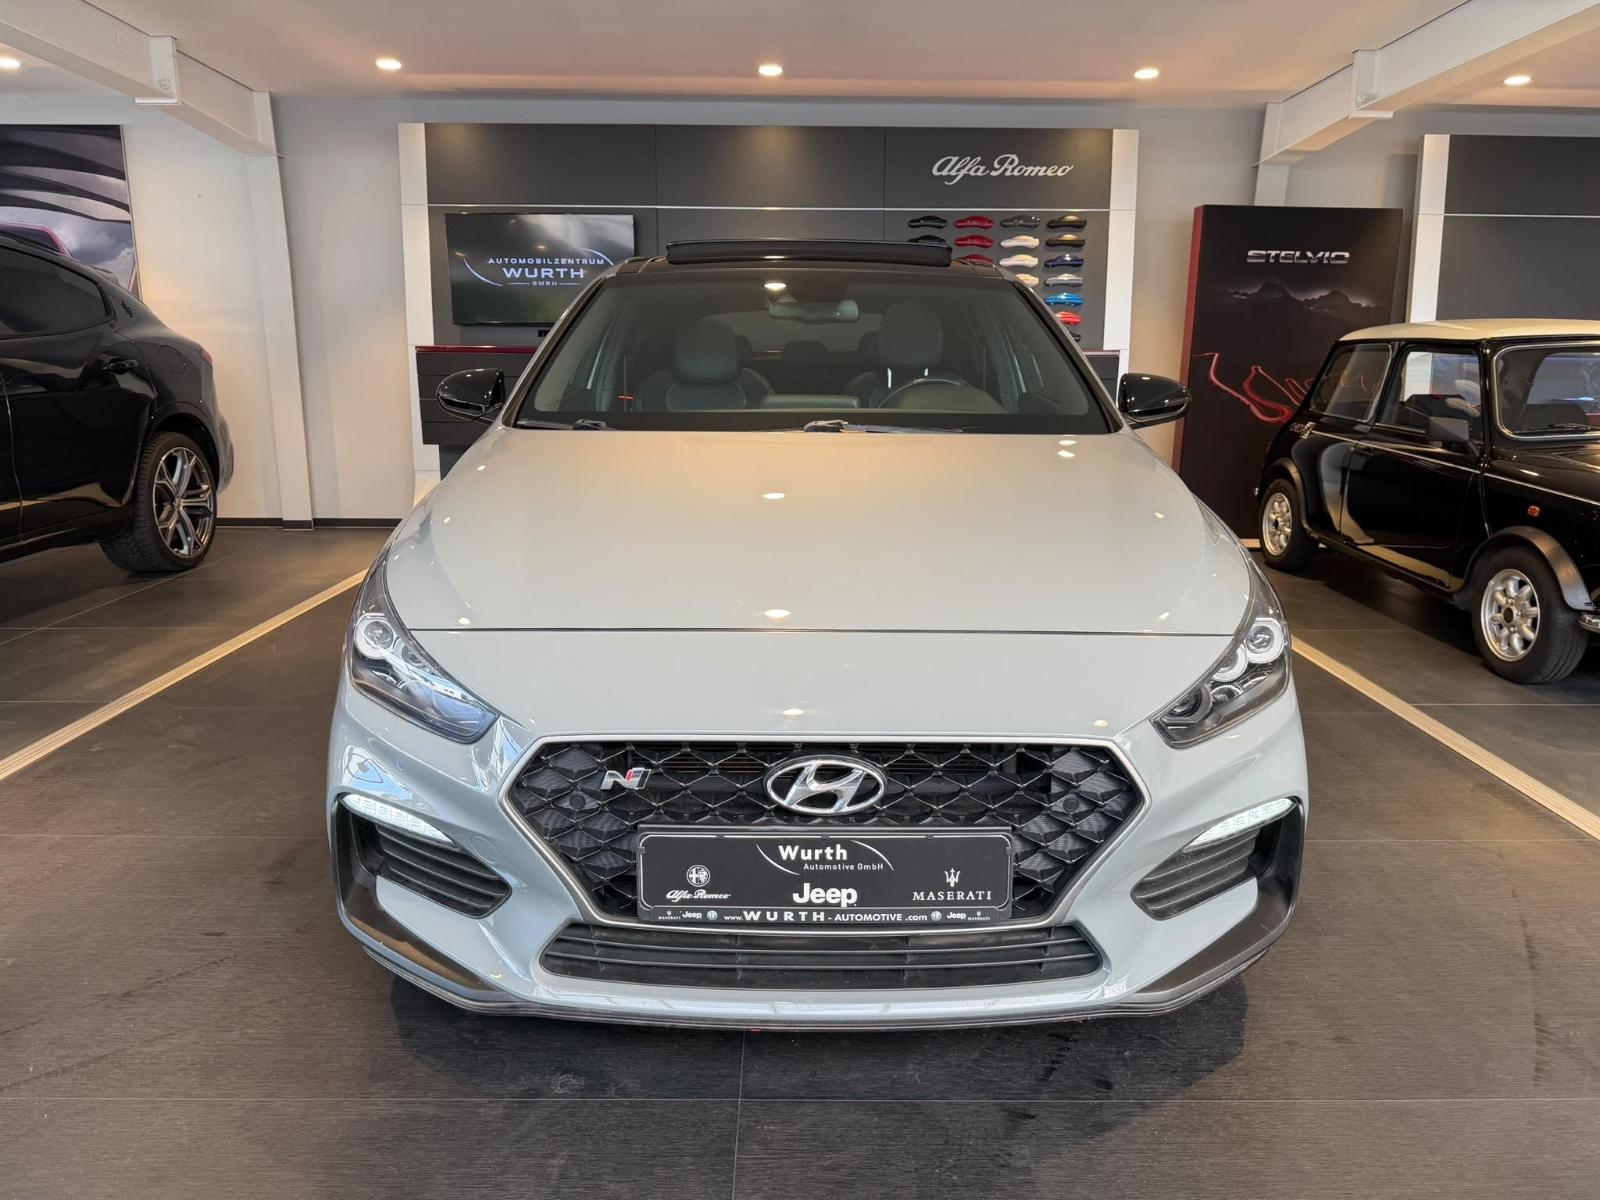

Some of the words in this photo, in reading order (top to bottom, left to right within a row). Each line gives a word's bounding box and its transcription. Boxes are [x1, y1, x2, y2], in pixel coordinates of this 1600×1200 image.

[931, 155, 990, 186] Alfa
[989, 153, 1074, 177] Romeo
[487, 257, 605, 265] AUTOMOBILZENTRUM
[1246, 250, 1351, 264] STELVIO
[502, 267, 584, 279] WURTH
[778, 843, 848, 861] Wurth
[803, 863, 855, 871] Automotive
[857, 863, 884, 871] GmbH
[665, 889, 694, 903] Alfa
[692, 888, 731, 900] Romeo
[792, 882, 858, 908] Jeep
[912, 890, 992, 901] MASERATI
[682, 910, 703, 919] Jeep
[946, 911, 967, 920] Jeep
